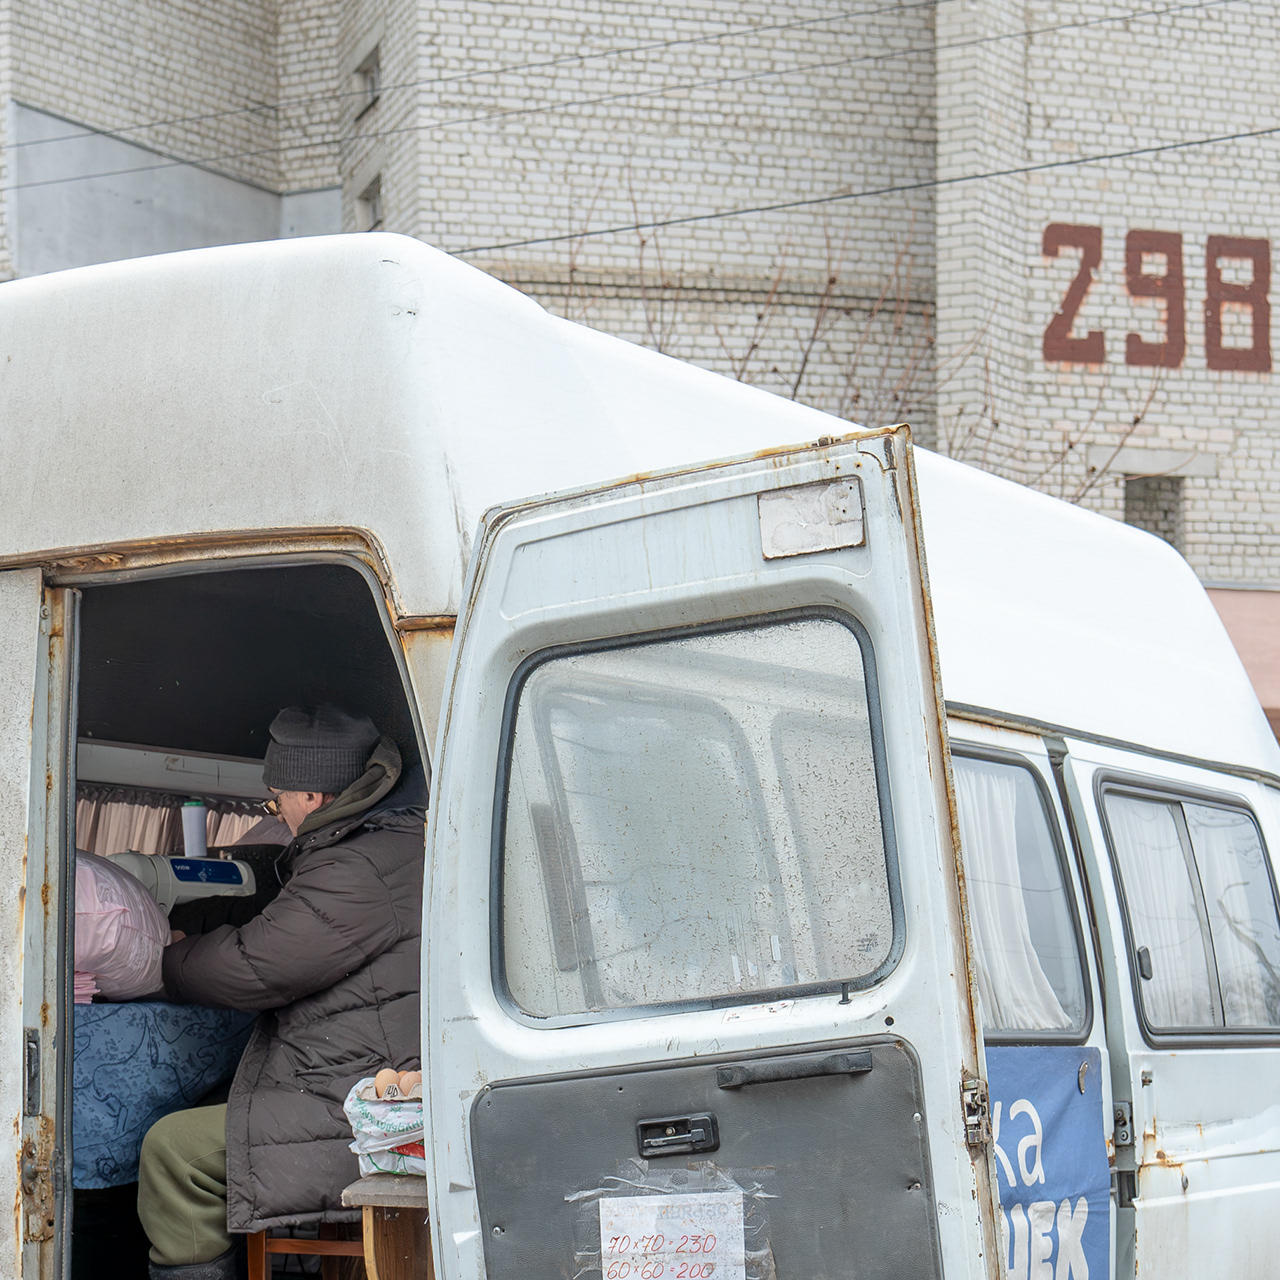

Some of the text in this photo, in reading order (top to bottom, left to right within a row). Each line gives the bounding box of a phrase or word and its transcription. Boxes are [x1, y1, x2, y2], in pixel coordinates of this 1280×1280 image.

[1042, 222, 1271, 373] 298
[676, 1234, 717, 1253] 230
[676, 1262, 714, 1279] 200
